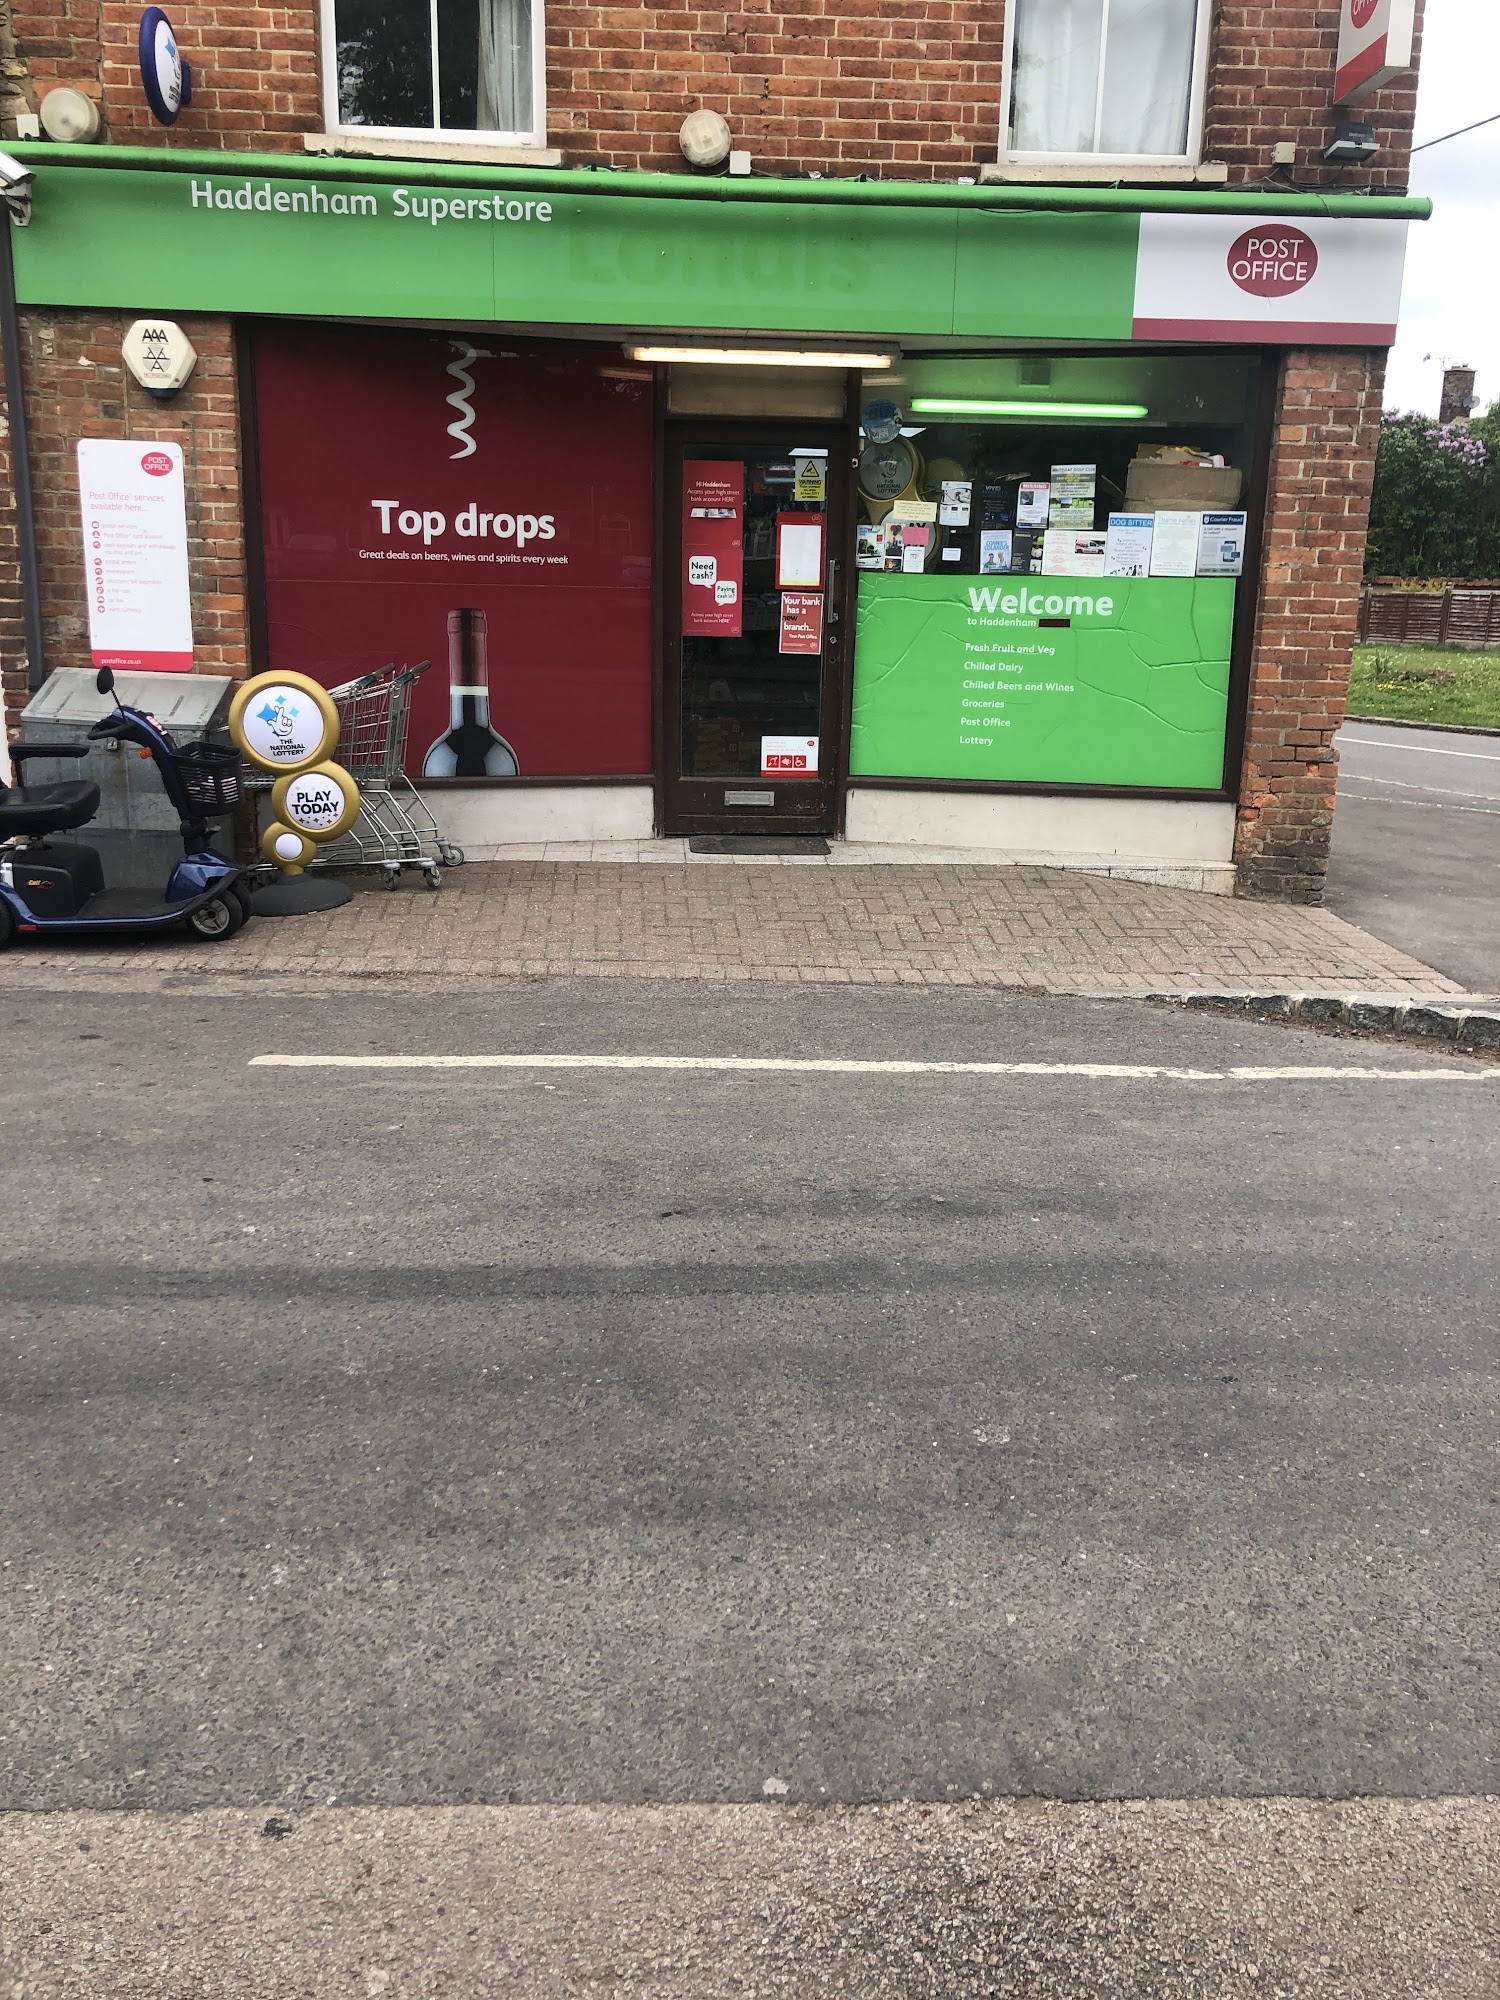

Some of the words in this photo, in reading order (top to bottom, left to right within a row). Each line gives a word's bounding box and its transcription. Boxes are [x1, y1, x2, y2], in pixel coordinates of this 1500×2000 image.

[191, 180, 377, 215] Haddenham
[392, 189, 553, 226] Superstore
[1247, 238, 1304, 259] POST
[1232, 260, 1308, 281] OFFICE
[142, 328, 168, 342] AAA
[148, 456, 166, 464] POST
[696, 480, 702, 488] Hi
[89, 492, 106, 500] Post
[134, 494, 165, 502] services
[90, 503, 122, 511] available
[371, 500, 446, 546] Top
[454, 502, 556, 548] drops
[358, 549, 385, 560] Great
[386, 550, 410, 560] deals
[411, 552, 422, 560] on
[424, 551, 450, 562] beers,
[451, 552, 474, 562] wines
[475, 553, 494, 562] and
[496, 553, 521, 564] spirits
[522, 555, 546, 566] every
[546, 554, 569, 564] week
[691, 561, 714, 570] Need
[691, 571, 714, 580] cash?
[716, 586, 736, 594] Paying
[782, 596, 801, 606] Your
[802, 596, 820, 606] bank
[968, 586, 1114, 616] Welcome
[786, 605, 800, 614] has
[967, 617, 978, 626] to
[980, 617, 1036, 627] Haddenham
[965, 642, 990, 652] Fresh
[992, 644, 1014, 652] Fruit
[1016, 644, 1034, 654] and
[1037, 645, 1056, 656] Veg
[964, 661, 996, 670] Chilled
[998, 662, 1024, 674] Dairy
[962, 680, 995, 690] Chilled
[996, 681, 1022, 690] Beers
[1024, 681, 1042, 691] and
[1045, 682, 1074, 692] Wines
[961, 698, 1005, 708] Groceries
[960, 717, 980, 726] Post
[982, 718, 1011, 727] Office
[959, 736, 994, 746] Lottery
[270, 743, 306, 751] NATIONAL
[272, 749, 305, 757] LOTTERY
[296, 790, 332, 803] PLAY
[292, 801, 340, 815] TODAY
